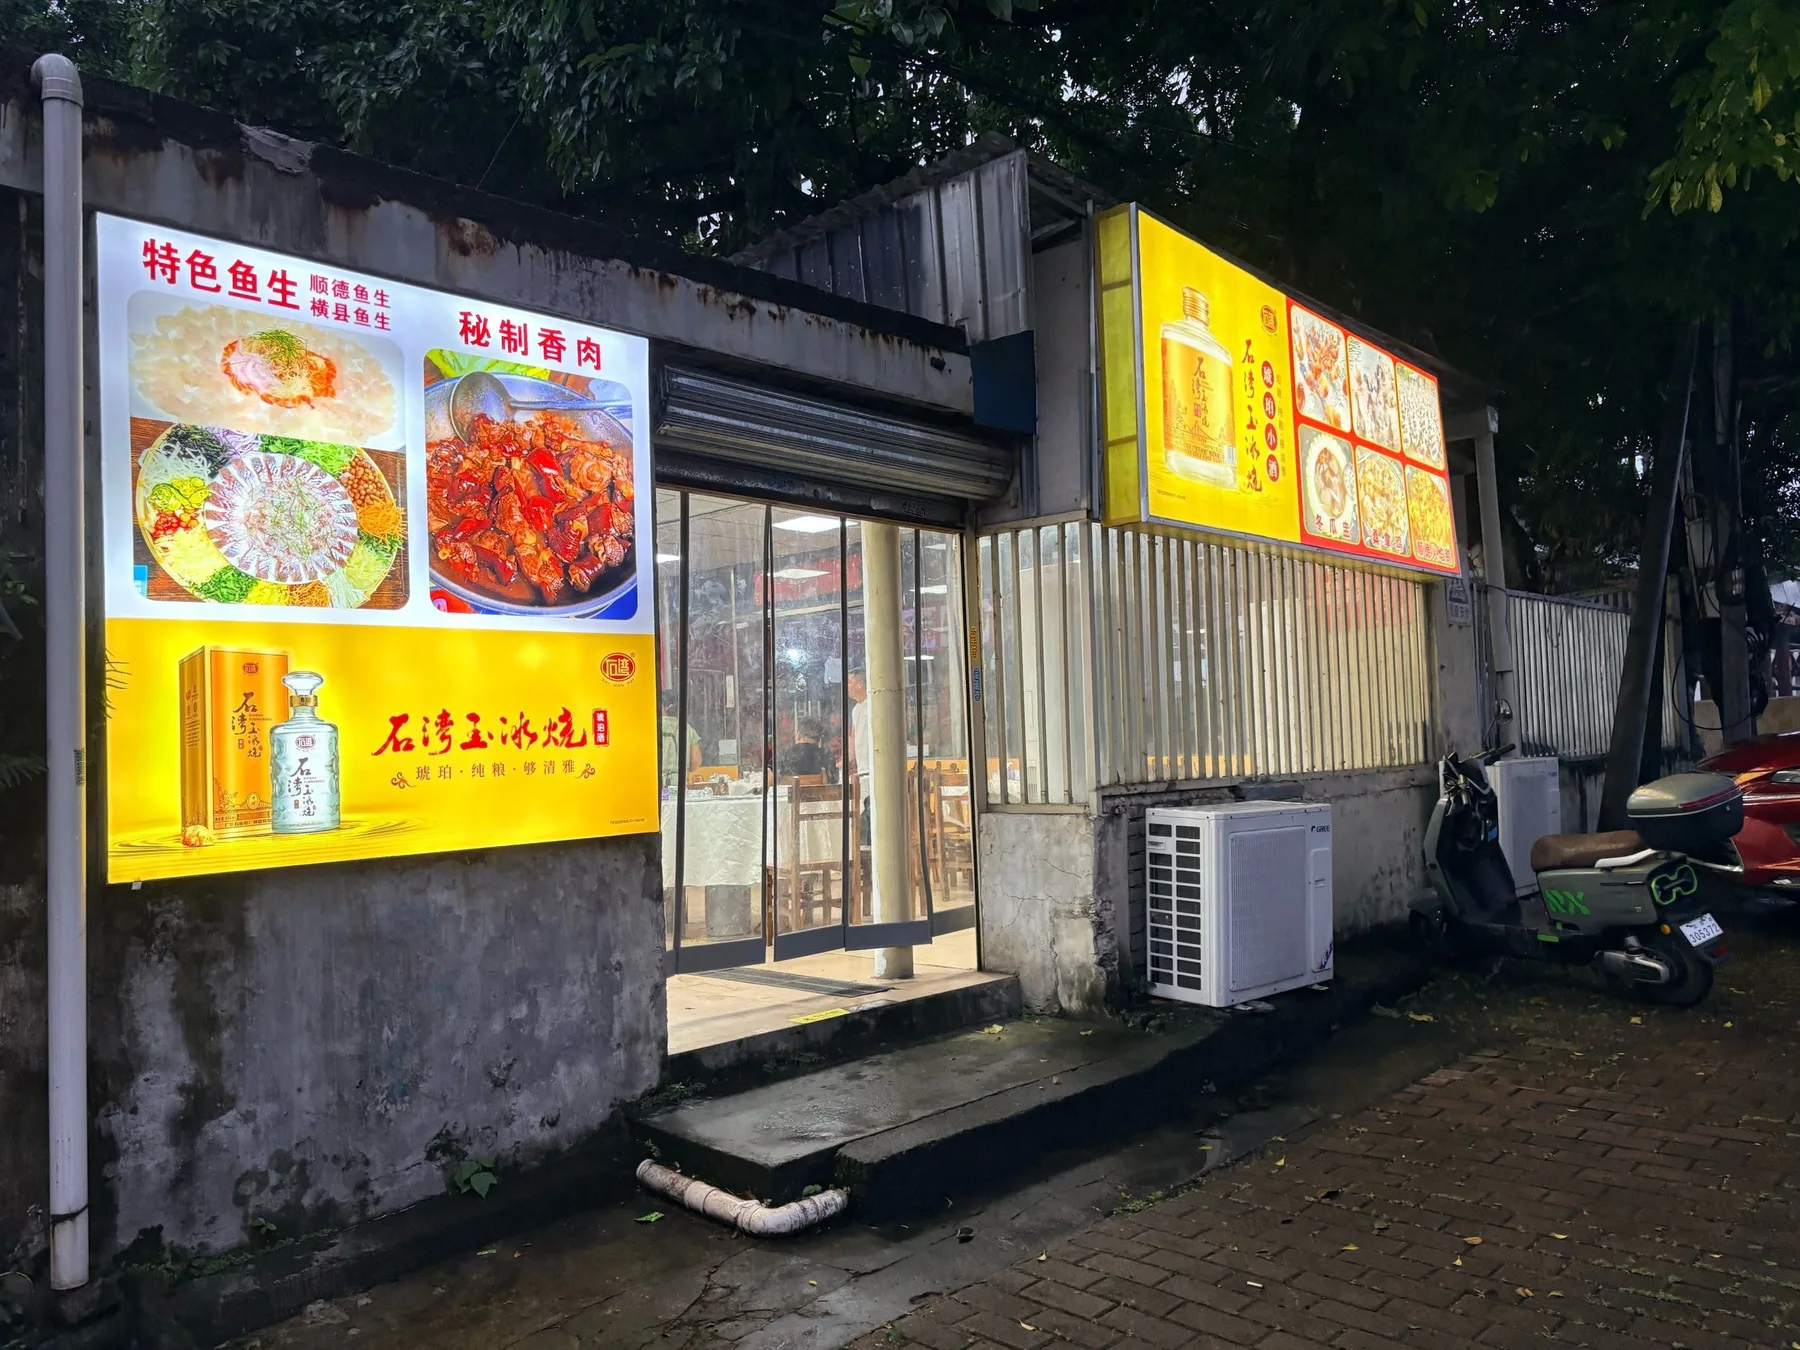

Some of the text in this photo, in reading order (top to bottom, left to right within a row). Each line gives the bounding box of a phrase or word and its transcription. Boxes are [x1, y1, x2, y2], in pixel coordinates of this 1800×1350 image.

[142, 238, 300, 310] 特色鱼生
[309, 274, 391, 309] 顺德鱼生
[310, 297, 392, 331] 横县鱼生
[459, 311, 602, 370] 秘制香肉
[1242, 339, 1262, 492] 石湾玉冰烧
[1262, 364, 1279, 480] 琥珀小酒
[371, 706, 587, 756] 石湾玉冰烧
[1689, 923, 1720, 943] 305372
